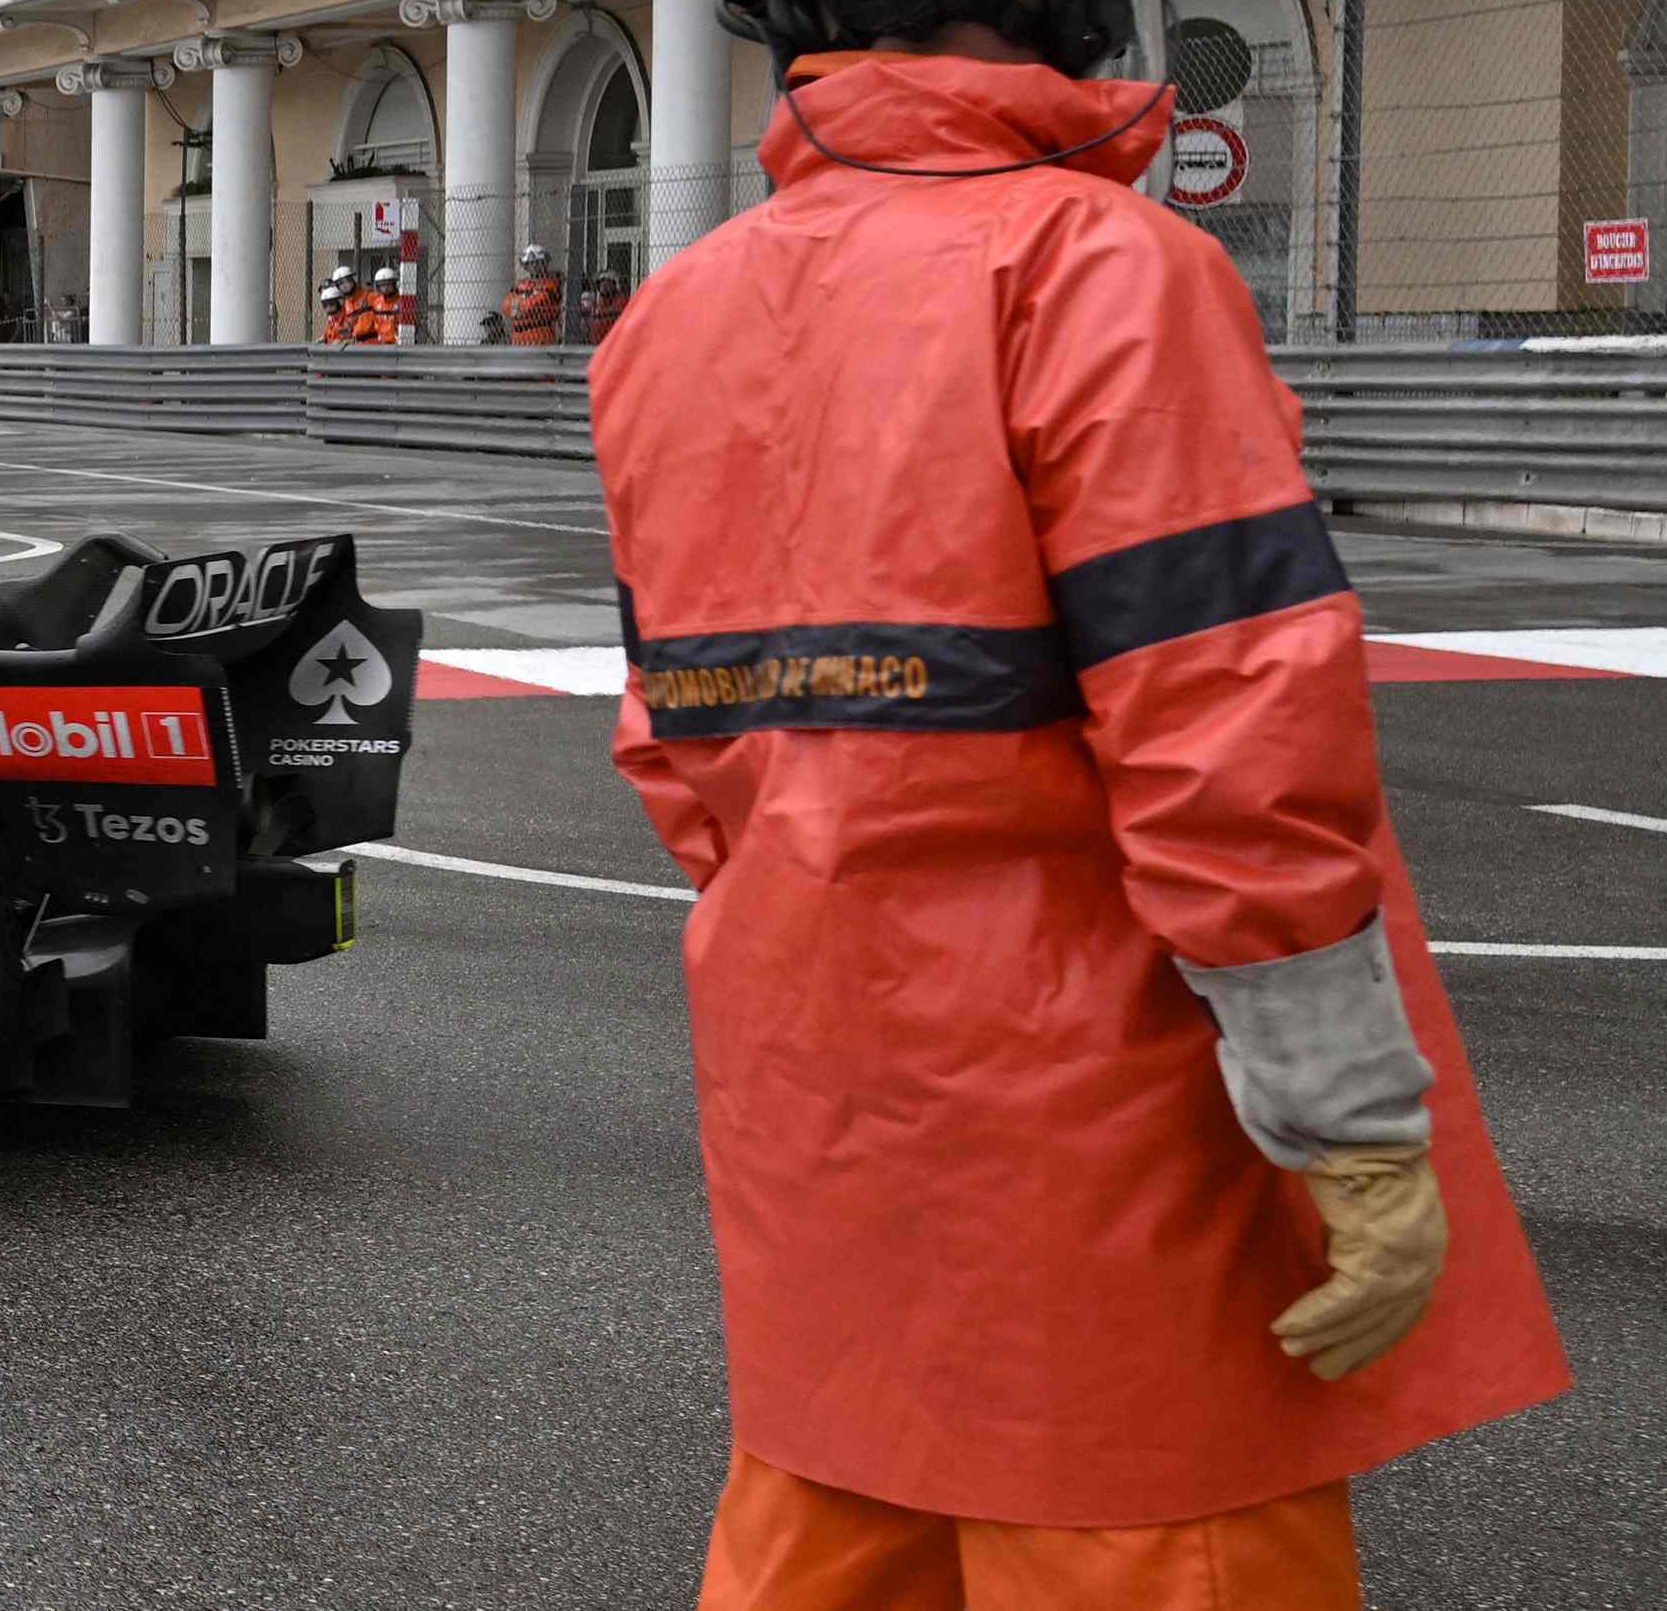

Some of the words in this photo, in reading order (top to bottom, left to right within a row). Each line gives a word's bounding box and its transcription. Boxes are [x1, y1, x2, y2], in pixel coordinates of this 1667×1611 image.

[160, 717, 184, 756] 1
[269, 738, 401, 755] POKERSTARS
[269, 753, 335, 768] CASINO
[75, 802, 210, 846] Tezos
